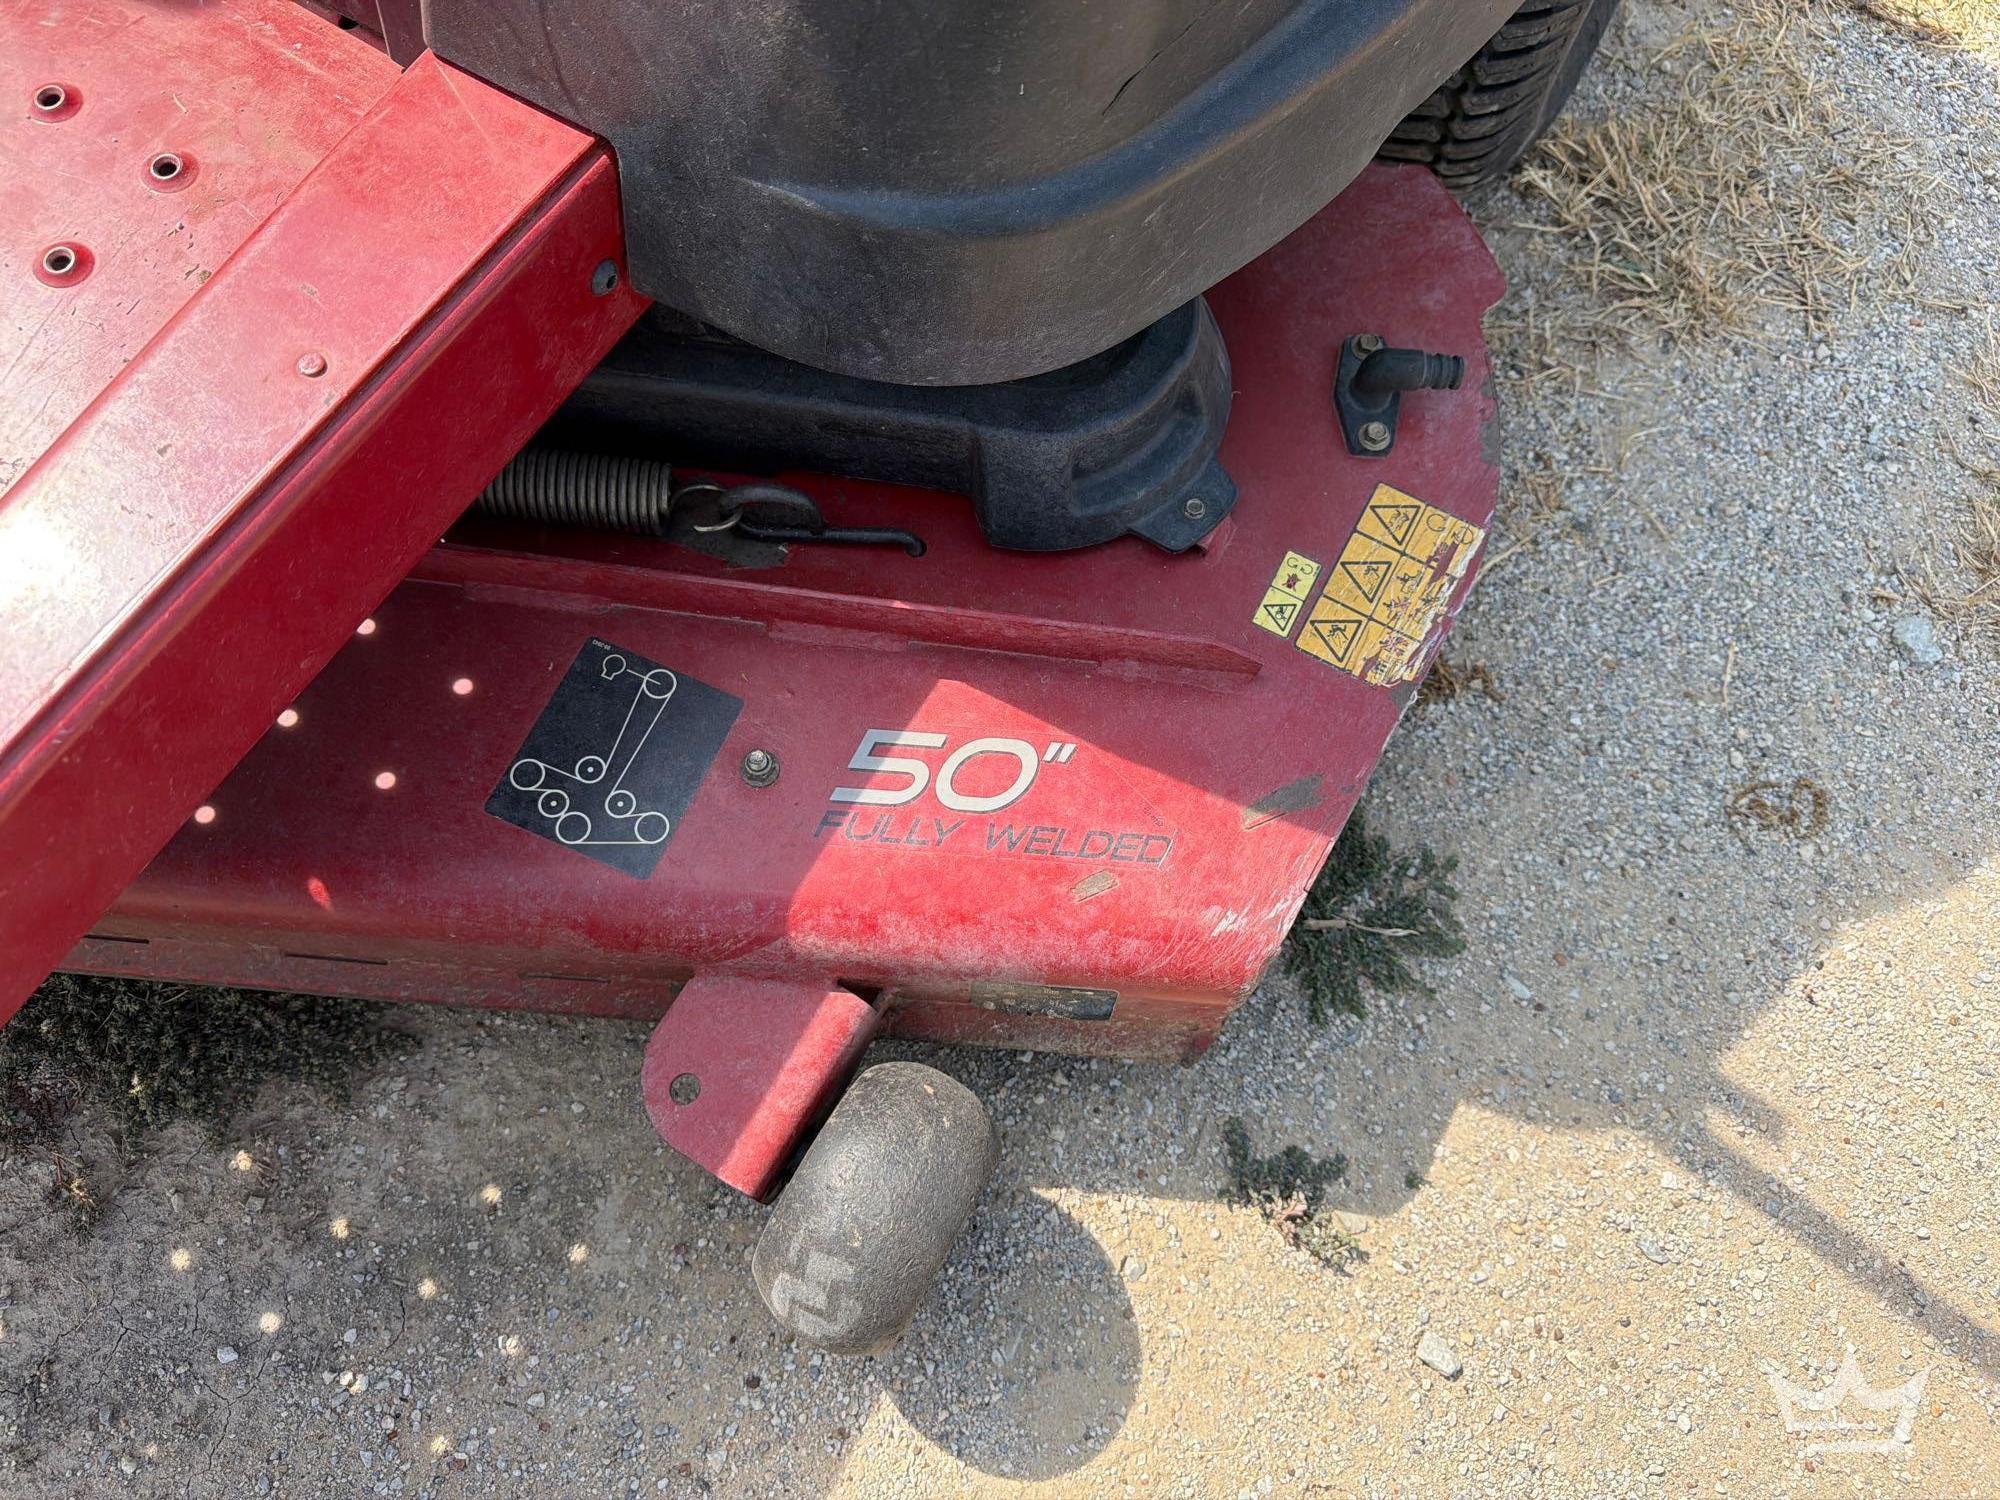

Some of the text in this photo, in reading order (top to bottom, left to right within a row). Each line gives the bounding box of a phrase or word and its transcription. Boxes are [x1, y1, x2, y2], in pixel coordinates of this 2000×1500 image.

[829, 728, 1078, 814] 50"
[812, 809, 1175, 866] FULLY WELDED
